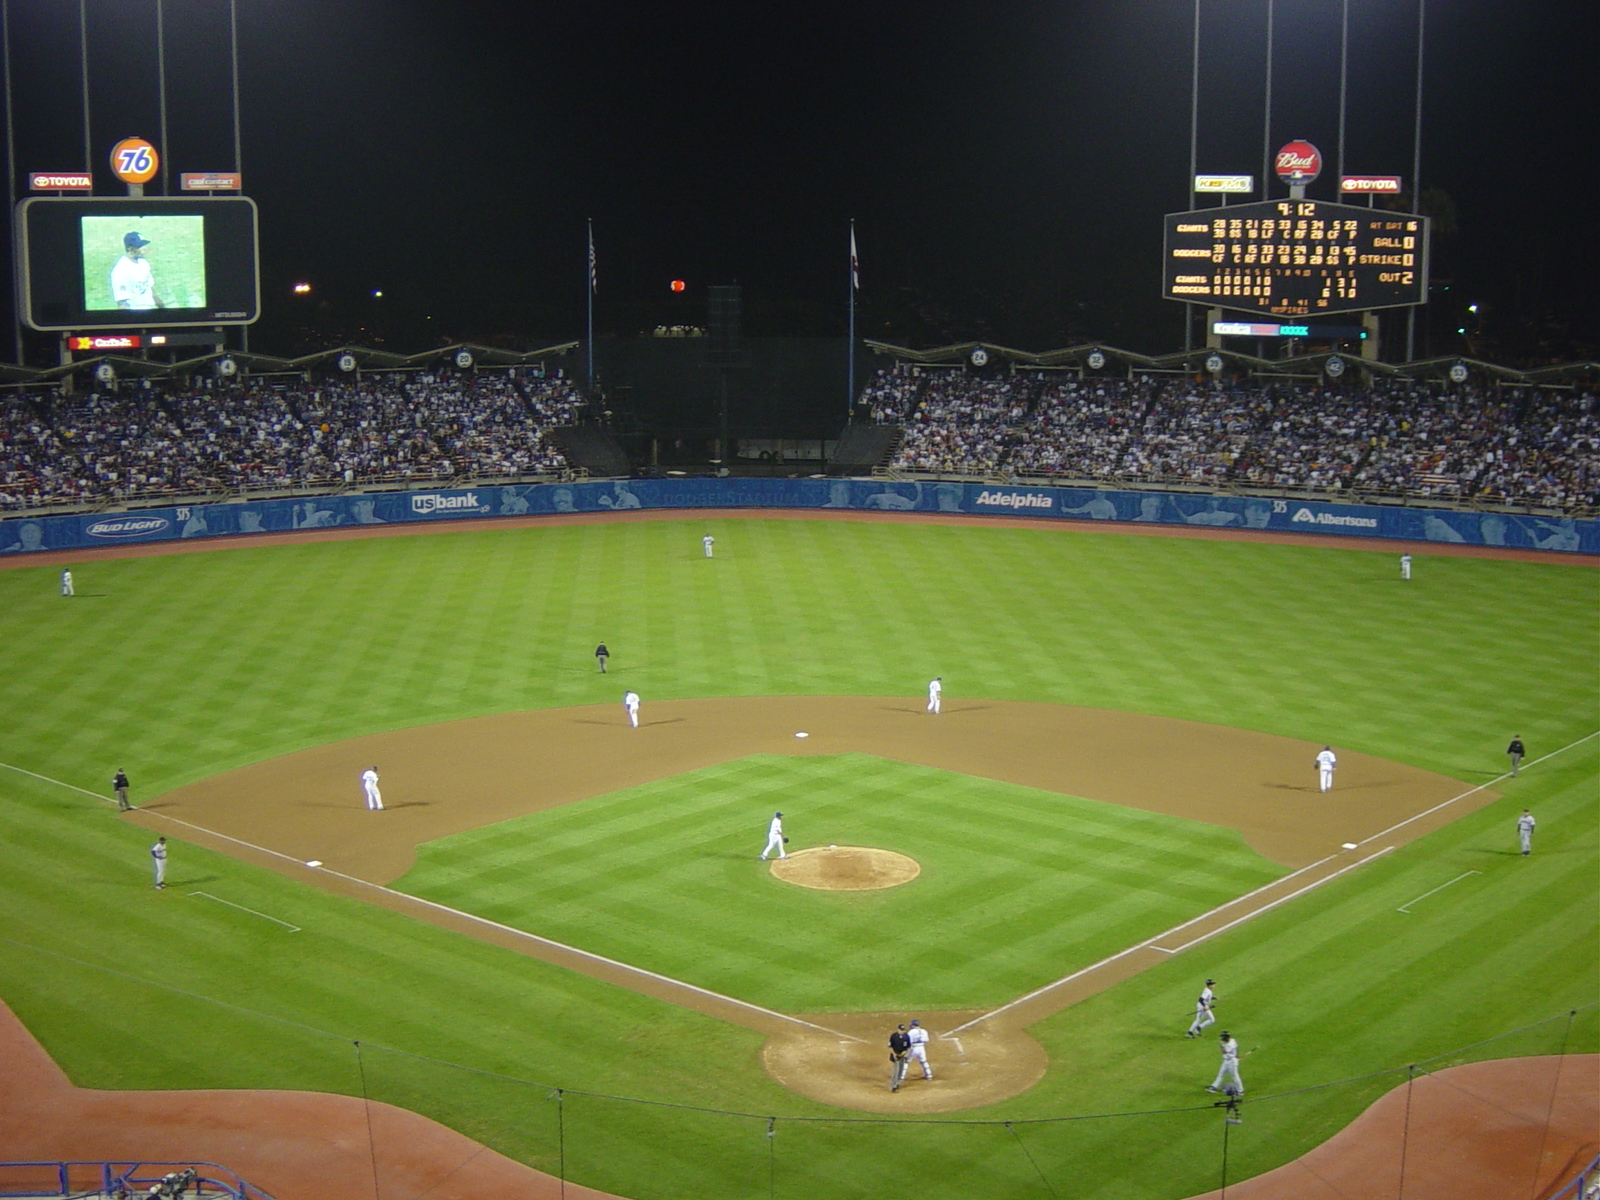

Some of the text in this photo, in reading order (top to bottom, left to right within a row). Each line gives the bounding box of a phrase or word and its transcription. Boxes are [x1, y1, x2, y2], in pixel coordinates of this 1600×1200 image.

[118, 147, 153, 174] 76
[1277, 153, 1315, 167] Bud
[49, 176, 90, 186] TOYOTA
[1357, 180, 1398, 190] TOYOTA
[1278, 203, 1315, 216] 9:12
[1246, 220, 1258, 228] 21
[1261, 220, 1275, 229] 25
[1278, 220, 1291, 229] 33
[1311, 220, 1324, 229] 34
[1344, 221, 1357, 230] 22
[1261, 230, 1274, 239] LF
[1283, 230, 1290, 239] C
[1327, 231, 1340, 239] CF
[1349, 231, 1357, 239] P
[1373, 238, 1402, 247] BALL
[1261, 245, 1274, 254] 33
[1277, 245, 1290, 254] 23
[1343, 246, 1356, 255] 45
[1212, 254, 1225, 263] CF
[1233, 254, 1241, 263] C
[1261, 255, 1273, 263] LF
[1326, 256, 1339, 265] SS
[1348, 256, 1356, 265] P
[1360, 255, 1401, 264] STRIKE
[1257, 276, 1261, 285] 1
[1326, 278, 1331, 286] 1
[1337, 278, 1345, 287] 3
[1351, 279, 1356, 287] 1
[1379, 272, 1413, 284] OUT 2
[1322, 288, 1330, 297] 6
[1337, 288, 1344, 297] 7
[459, 355, 470, 364] 20
[975, 352, 984, 361] 24
[344, 359, 350, 368] 19
[975, 491, 1053, 509] Adelphia
[176, 508, 190, 521] 375
[1316, 513, 1377, 527] Albertsons
[91, 520, 163, 533] BUD LIGHT
